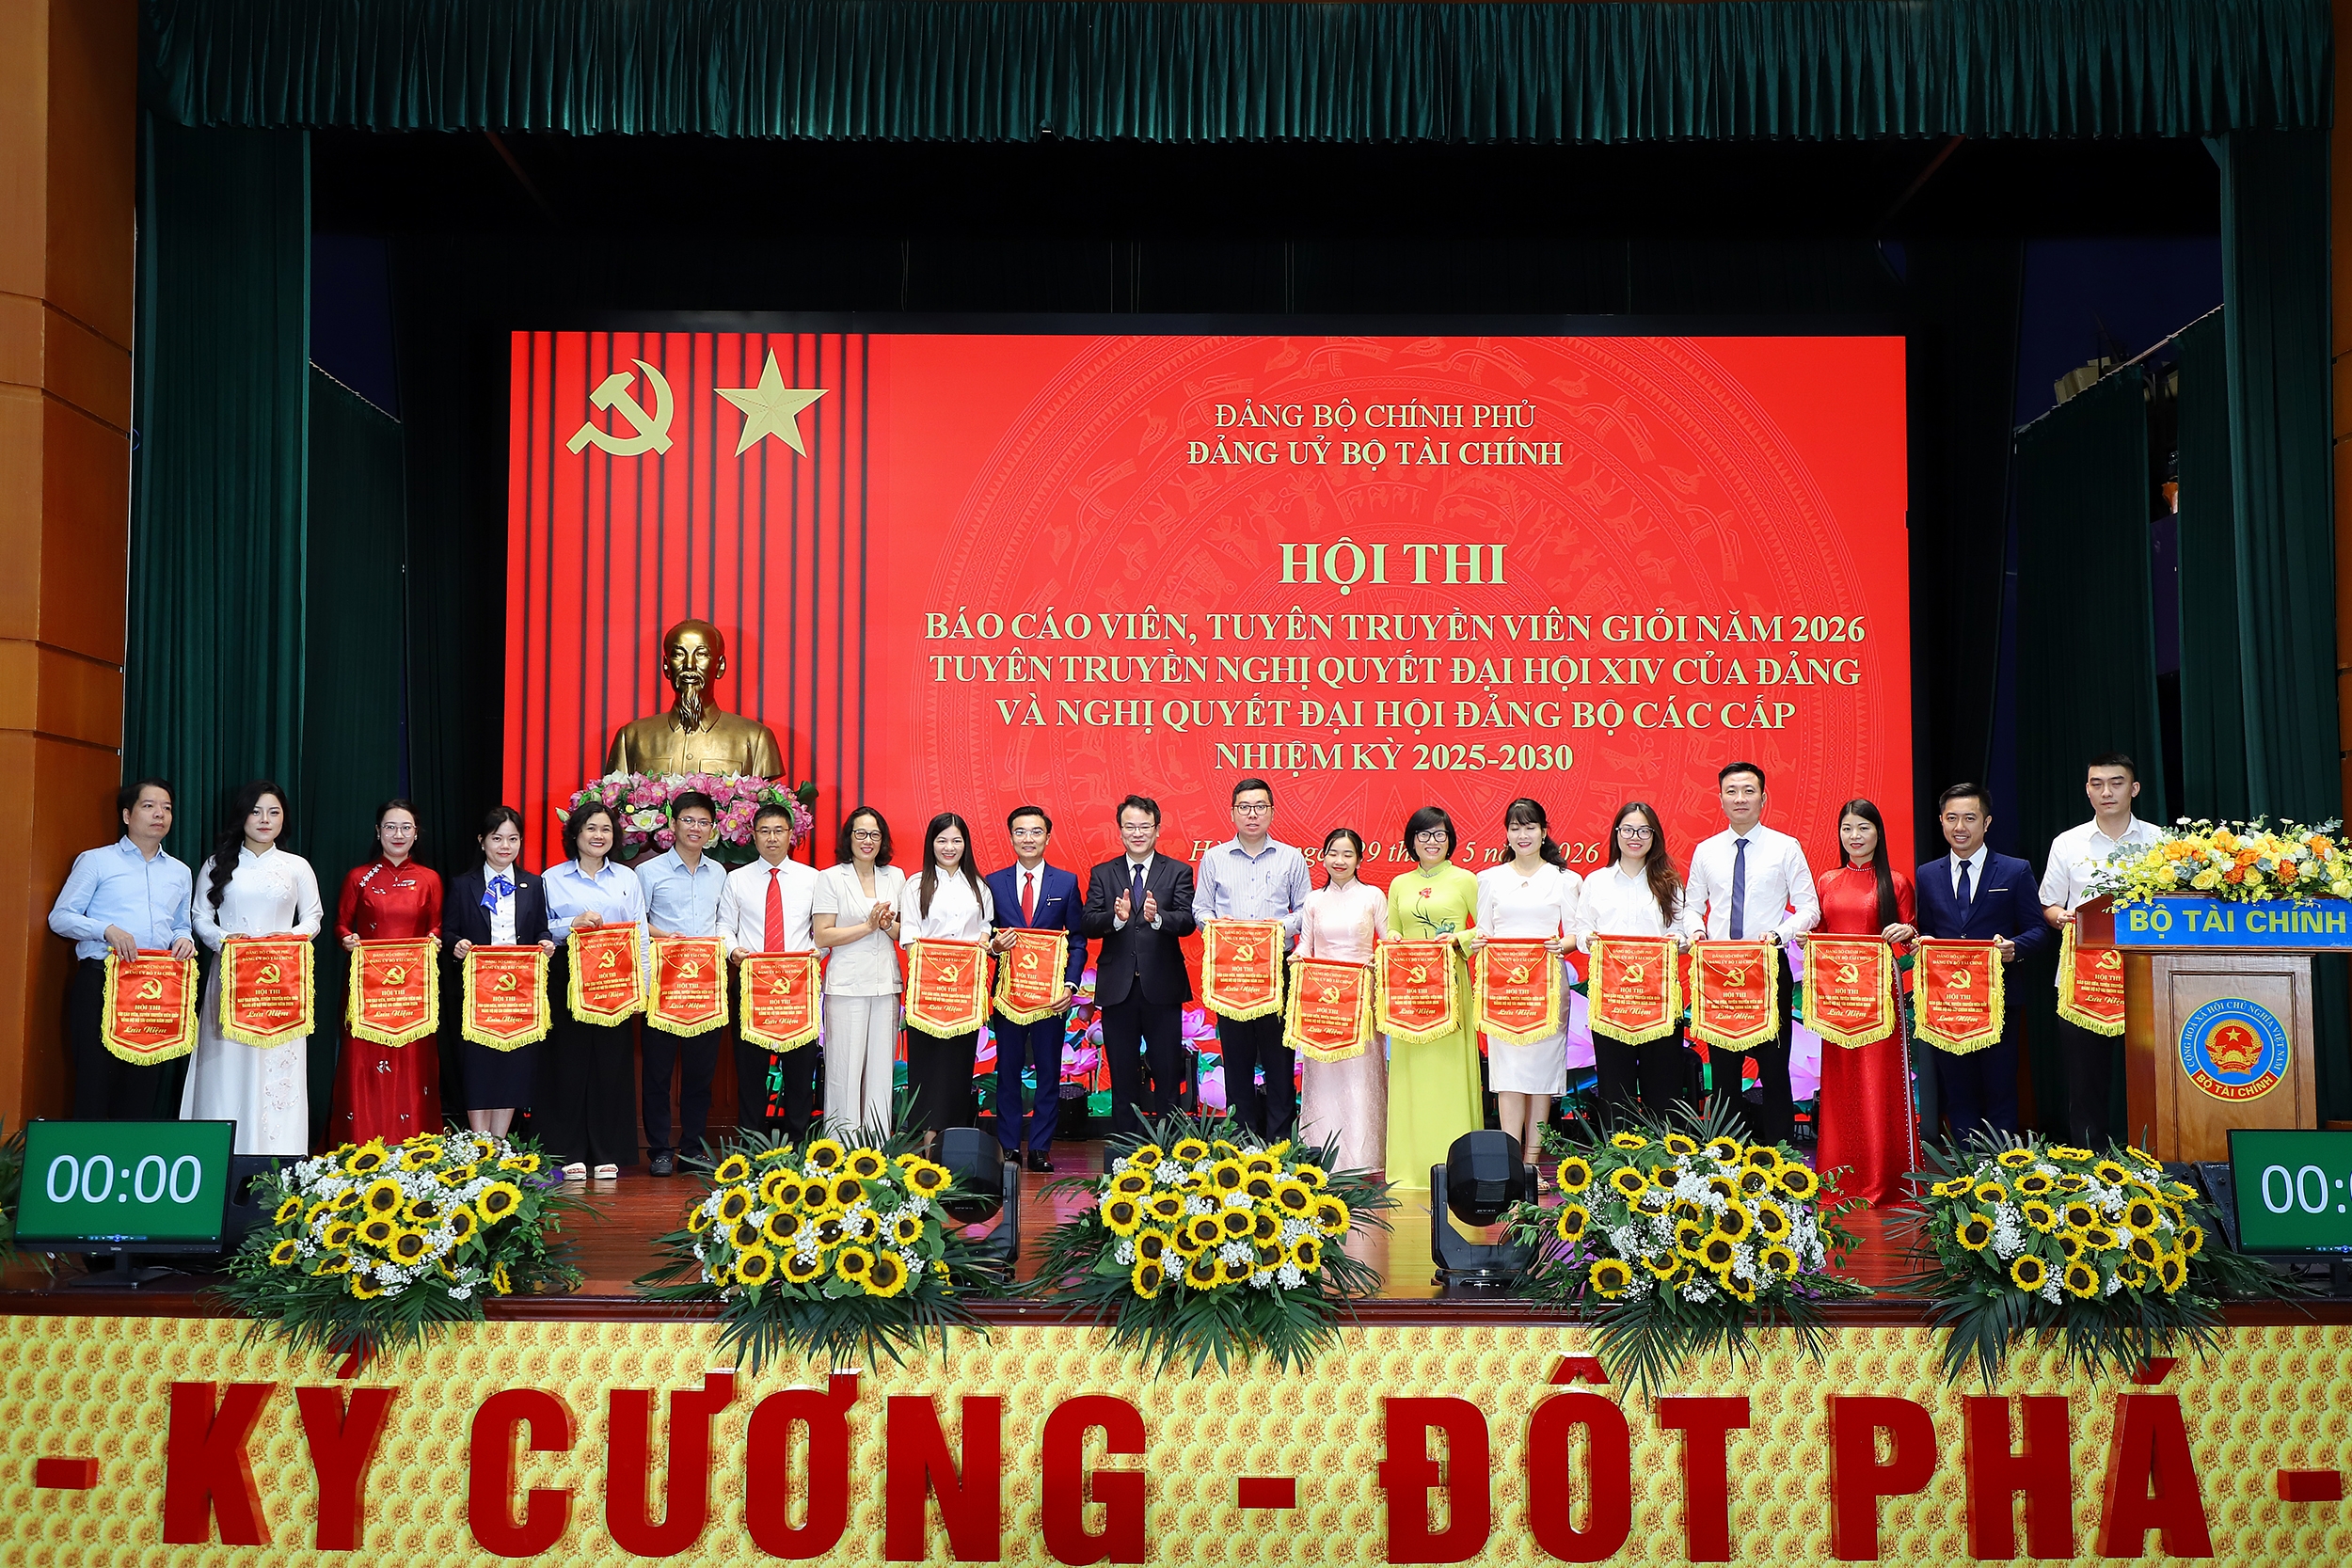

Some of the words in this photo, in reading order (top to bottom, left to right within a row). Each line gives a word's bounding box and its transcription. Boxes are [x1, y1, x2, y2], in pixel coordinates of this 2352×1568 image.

[1216, 398, 1303, 428] ĐẢNG
[1312, 397, 1358, 432] BỘ
[1364, 398, 1464, 428] CHÍNH
[1472, 398, 1536, 428] PHỦ
[1187, 434, 1279, 466] ĐẢNG
[1289, 435, 1332, 466] UỶ
[1342, 438, 1387, 472] BỘ
[1394, 435, 1451, 466] TÀI
[1458, 435, 1564, 466] CHÍNH
[1278, 537, 1390, 595] HỘI
[1404, 544, 1507, 584] THI
[925, 607, 1005, 641] BÁO
[1011, 607, 1091, 641] CÁO
[1100, 605, 1198, 646] VIÊN,
[1206, 605, 1334, 641] TUYÊN
[1341, 607, 1496, 642] TRUYỀN
[1504, 607, 1592, 642] VIÊN
[1601, 607, 1687, 642] GIỎI
[1696, 610, 1783, 642] NĂM
[1790, 615, 1866, 642] 2026
[930, 647, 1053, 683] TUYÊN
[1059, 648, 1207, 684] TRUYỀN
[1216, 657, 1311, 691] NGHỊ
[1318, 650, 1441, 689] QUYẾT
[1449, 657, 1511, 692] ĐẠI
[1523, 656, 1591, 692] HỘI
[1599, 657, 1663, 686] XIV
[1672, 651, 1750, 687] CỦA
[1755, 651, 1861, 687] ĐẢNG
[996, 692, 1049, 727] VÀ
[1056, 699, 1154, 735] NGHỊ
[1162, 692, 1291, 732] QUYẾT
[1297, 700, 1362, 735] ĐẠI
[1375, 699, 1444, 736] HỘI
[1454, 693, 1562, 729] ĐẢNG
[1572, 699, 1625, 736] BỘ
[1632, 694, 1712, 729] CÁC
[1721, 694, 1796, 729] CẤP
[1215, 741, 1343, 778] NHIỆM
[1351, 736, 1400, 770] KỲ
[1411, 743, 1573, 771] 2025-2030
[1462, 842, 1476, 863] 5
[1559, 841, 1601, 863] 026
[2130, 904, 2172, 939] BỘ
[2183, 905, 2233, 931] TÀI
[2246, 904, 2346, 933] CHÍNH
[2195, 1011, 2207, 1022] XÃ
[2207, 1002, 2224, 1013] HỘI
[2227, 1001, 2247, 1009] CHỦ
[2248, 1006, 2274, 1027] NGHĨA
[2184, 1042, 2195, 1068] CỘNG
[2273, 1027, 2284, 1048] VIỆT
[2274, 1050, 2284, 1070] NAM
[2196, 1073, 2213, 1090] BỘ
[2216, 1085, 2233, 1097] TÀI
[2238, 1076, 2273, 1097] CHÍNH
[46, 1155, 202, 1204] 00:00
[35, 1455, 100, 1491] -
[468, 1367, 1147, 1566] CƯƠNG
[1236, 1476, 1297, 1510] -
[1826, 1355, 2217, 1562] PHÁ
[2275, 1465, 2344, 1503] -
